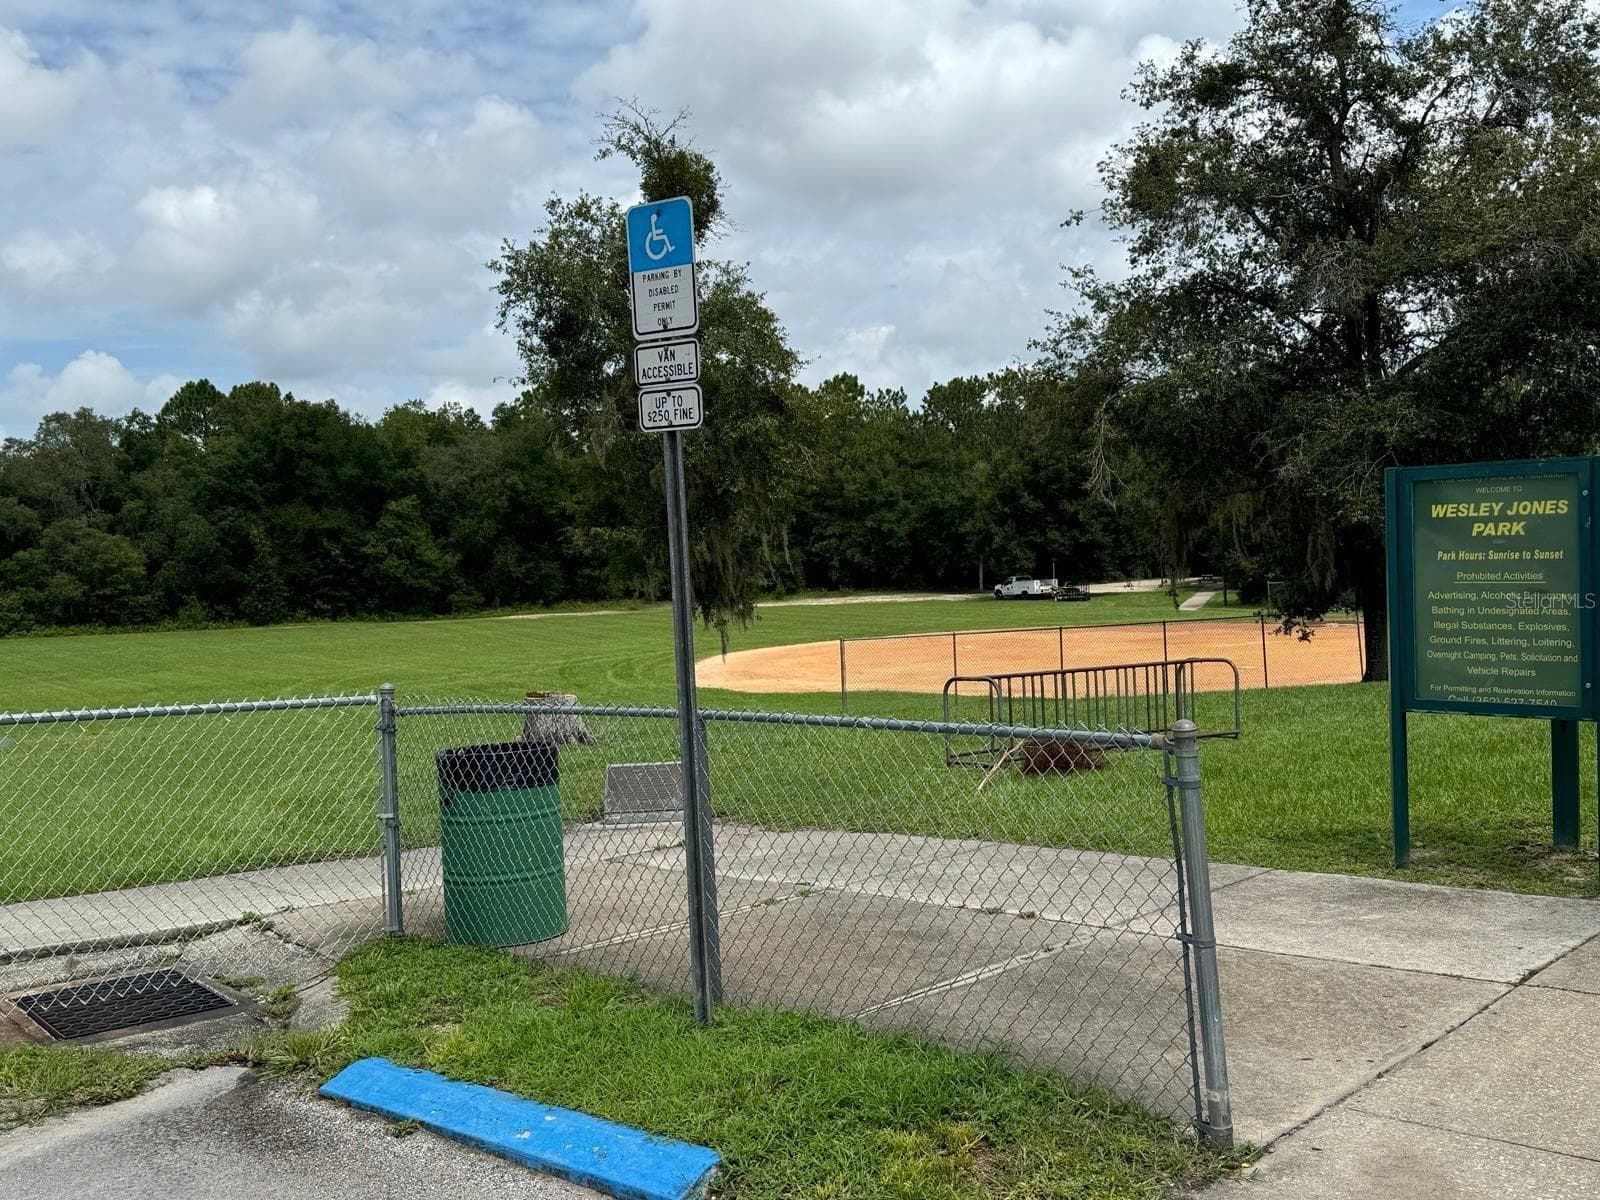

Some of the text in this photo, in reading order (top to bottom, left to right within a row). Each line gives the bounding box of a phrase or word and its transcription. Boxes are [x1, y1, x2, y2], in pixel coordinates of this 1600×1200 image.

[642, 268, 682, 283] PARKING BY
[649, 285, 678, 297] DISABLED
[654, 300, 676, 311] PERMIT
[658, 316, 673, 326] ONLY
[658, 349, 676, 362] VAN
[642, 362, 694, 380] ACCESSIBLE
[655, 395, 682, 409] UP TO
[648, 408, 694, 422] $250 FINE
[1476, 486, 1510, 494] WELCOME
[1431, 500, 1568, 518] WESLEY JONES
[1472, 521, 1527, 536] PARK
[1438, 550, 1564, 560] Park Hours: Sunrise to Sunset
[1456, 572, 1544, 581] Prohibited Activities
[1428, 592, 1479, 601] Advertising,
[1432, 606, 1572, 616] Bathing in Undesignated Areas,
[1434, 622, 1570, 632] Illegal Substances, Explosives,
[1430, 636, 1574, 648] Ground Fires, Littering, Loitering,
[1426, 651, 1578, 662] Overnight Camping, Pets, Solicitation and
[1467, 666, 1536, 677] Vehicle Repairs
[1444, 684, 1476, 693] Permitting
[1493, 687, 1534, 695] Reservation
[1536, 689, 1576, 697] Information
